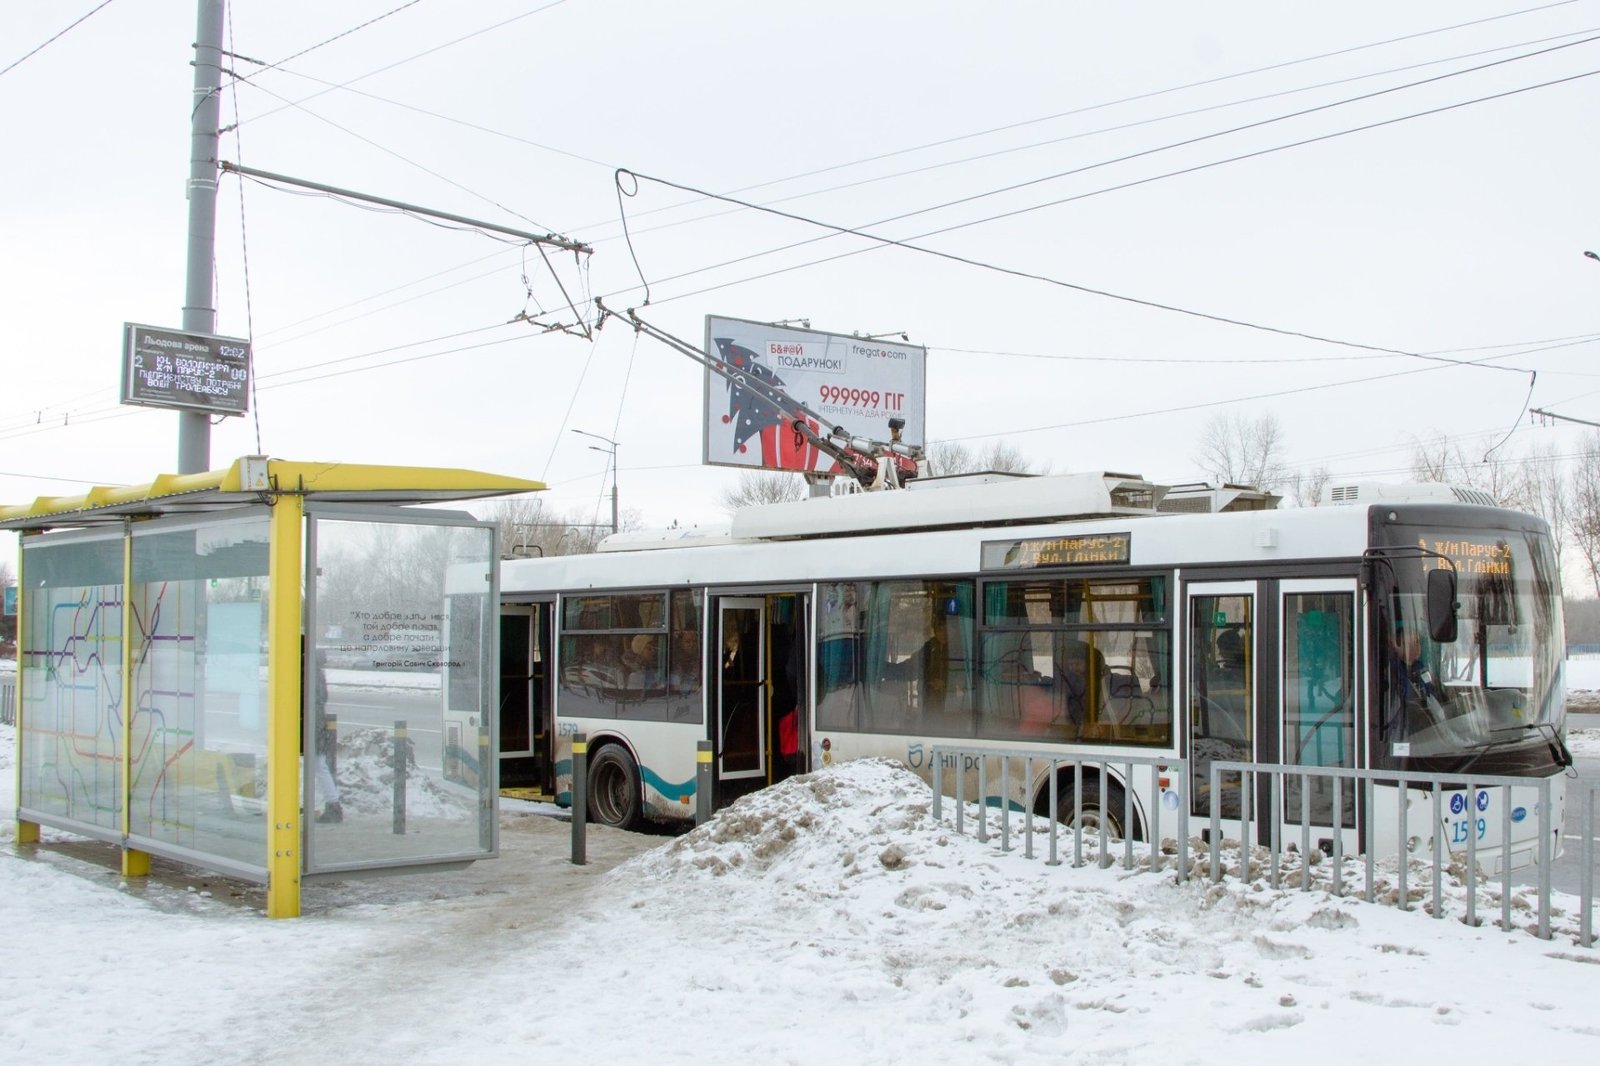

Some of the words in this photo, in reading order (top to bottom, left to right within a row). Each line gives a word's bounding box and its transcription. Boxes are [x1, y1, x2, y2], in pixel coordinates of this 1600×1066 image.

[144, 335, 182, 349] Льодова
[184, 341, 209, 352] арена
[220, 345, 245, 358] 12:02
[134, 355, 143, 368] 2
[778, 356, 842, 370] ПОДАРУНОК!
[819, 384, 880, 409] 999999
[853, 408, 864, 416] НА
[865, 409, 880, 418] ДВА
[372, 611, 402, 621] добре
[362, 622, 379, 631] той
[380, 622, 410, 632] добре
[362, 633, 370, 641] а
[371, 633, 401, 643] добре
[354, 644, 409, 653] наполовину
[403, 660, 426, 668] Савич
[1452, 818, 1486, 843] 159
